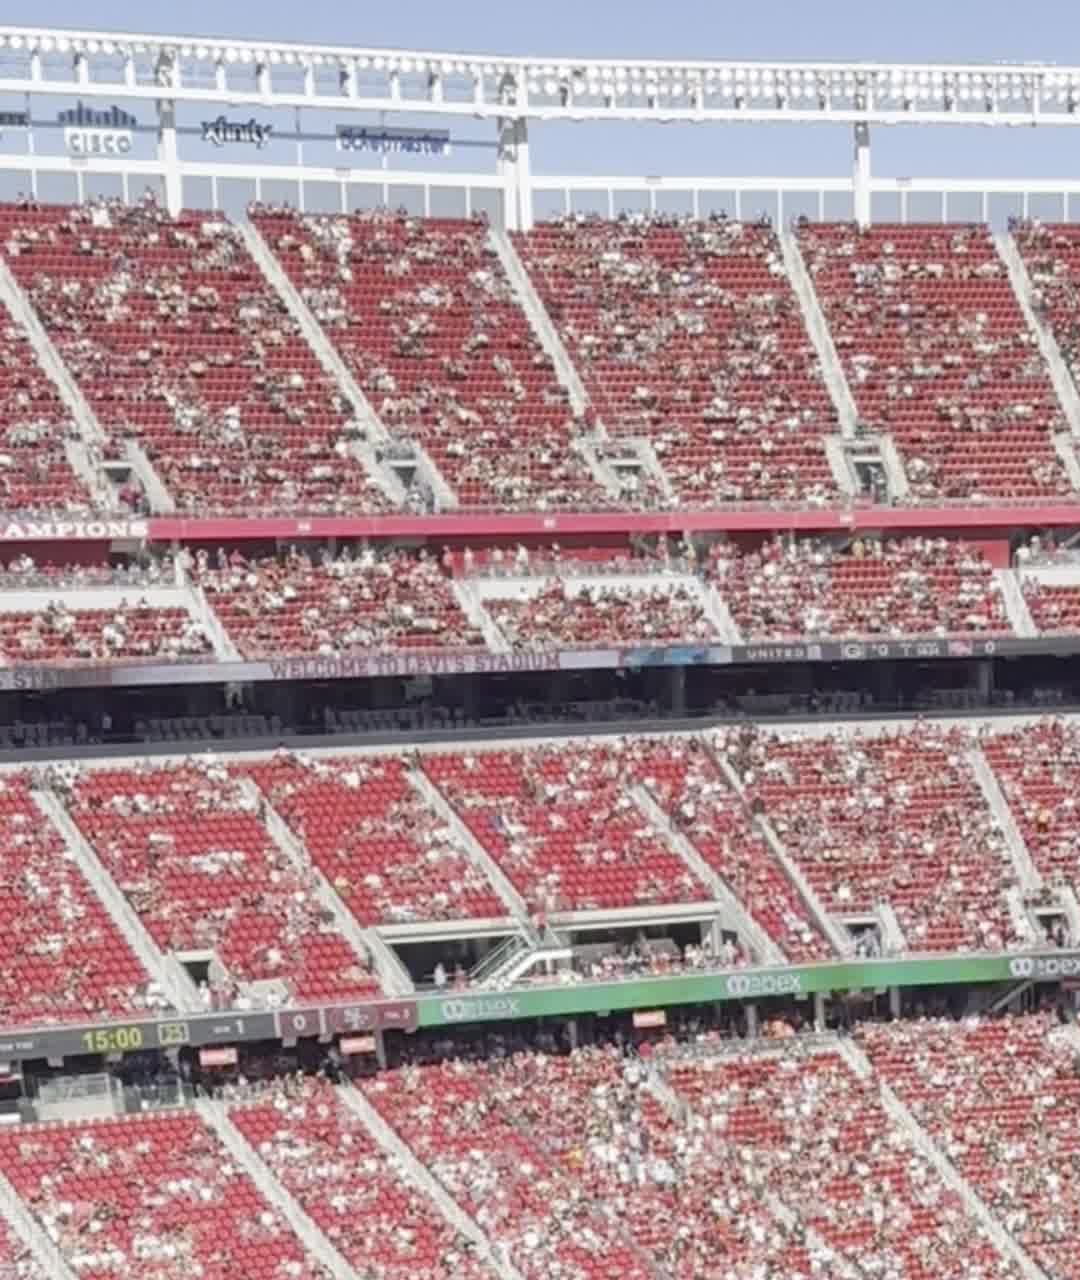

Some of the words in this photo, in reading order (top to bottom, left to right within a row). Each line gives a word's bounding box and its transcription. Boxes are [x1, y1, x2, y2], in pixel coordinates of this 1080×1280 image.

[270, 659, 369, 679] WELCOME
[476, 652, 560, 672] STADIUM
[82, 1027, 143, 1051] 15:00
